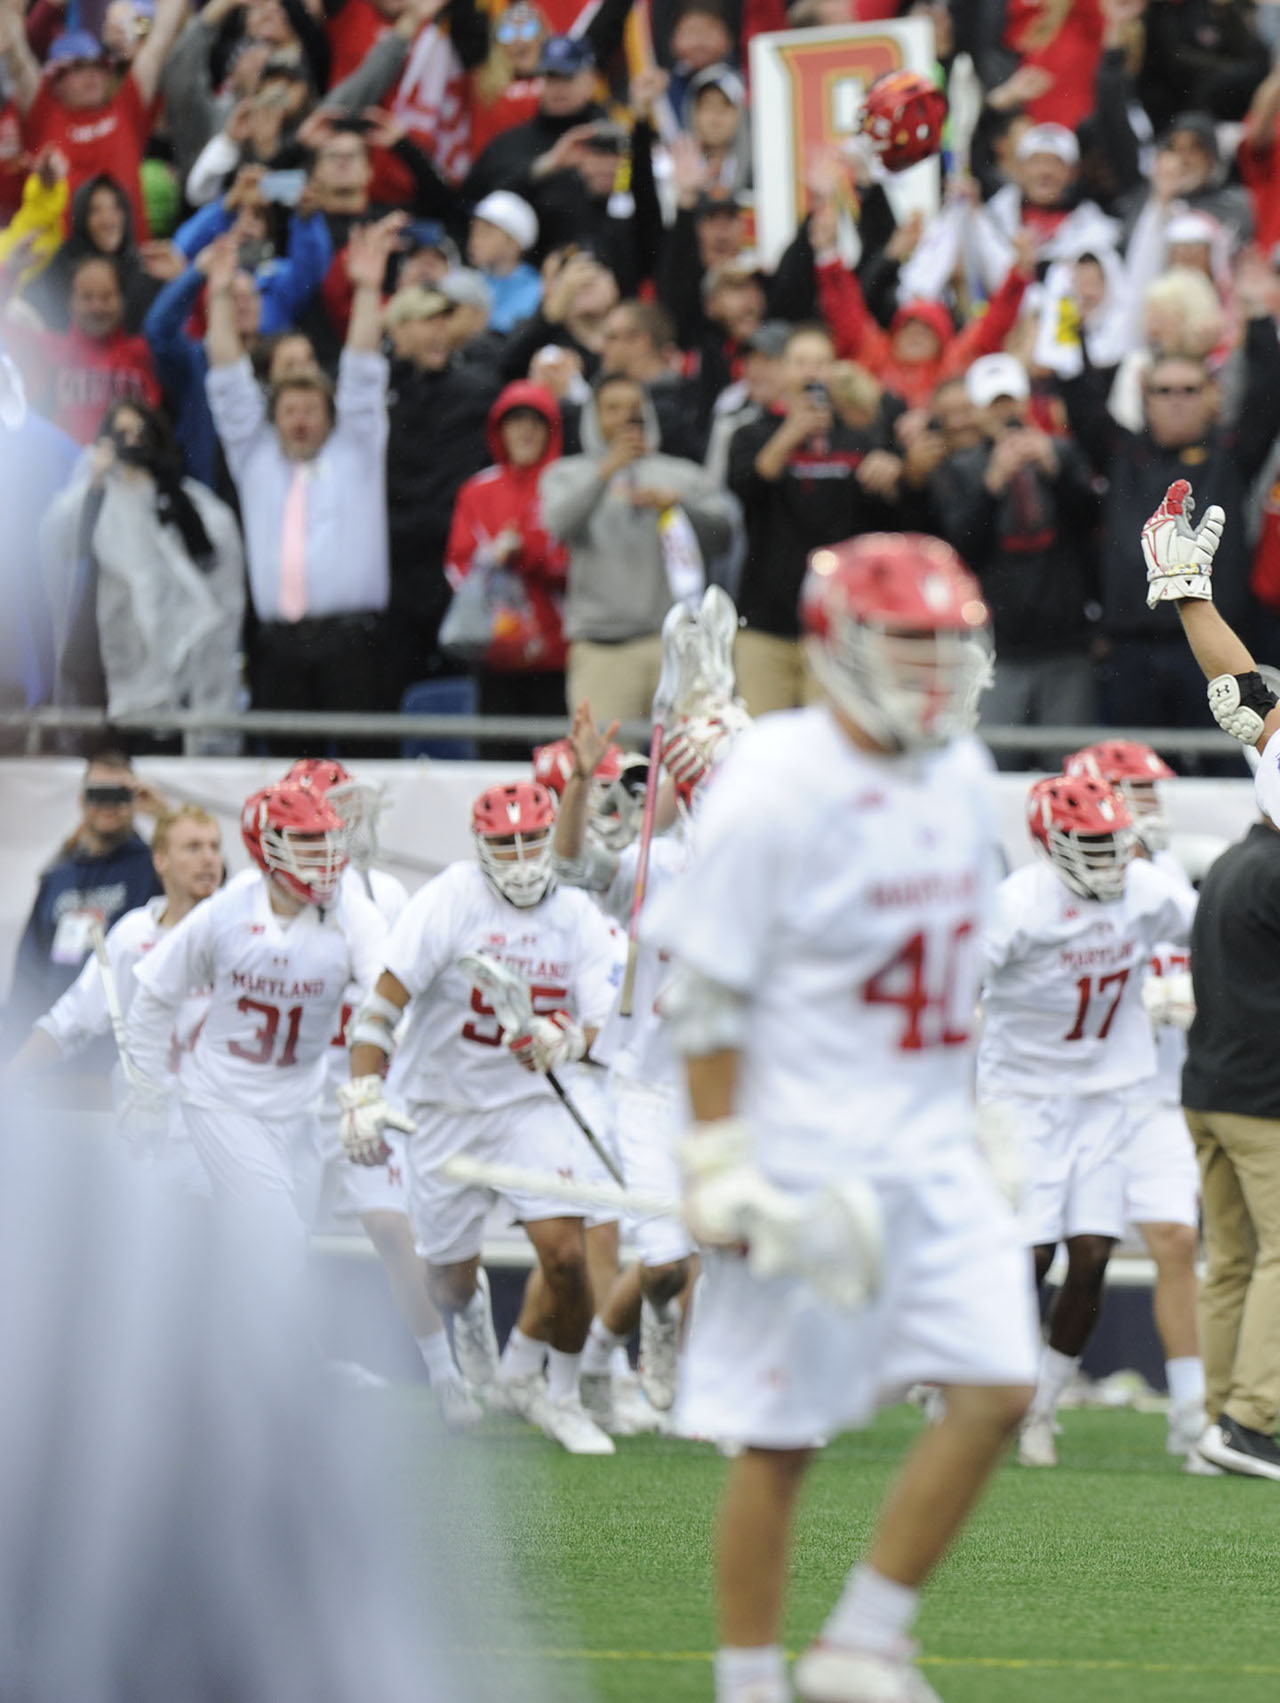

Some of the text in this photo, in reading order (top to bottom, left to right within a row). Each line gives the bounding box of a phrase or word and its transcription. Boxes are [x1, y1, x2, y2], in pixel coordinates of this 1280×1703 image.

[231, 968, 325, 998] MARYLAND
[1064, 968, 1131, 1040] 17
[226, 995, 304, 1067] 31
